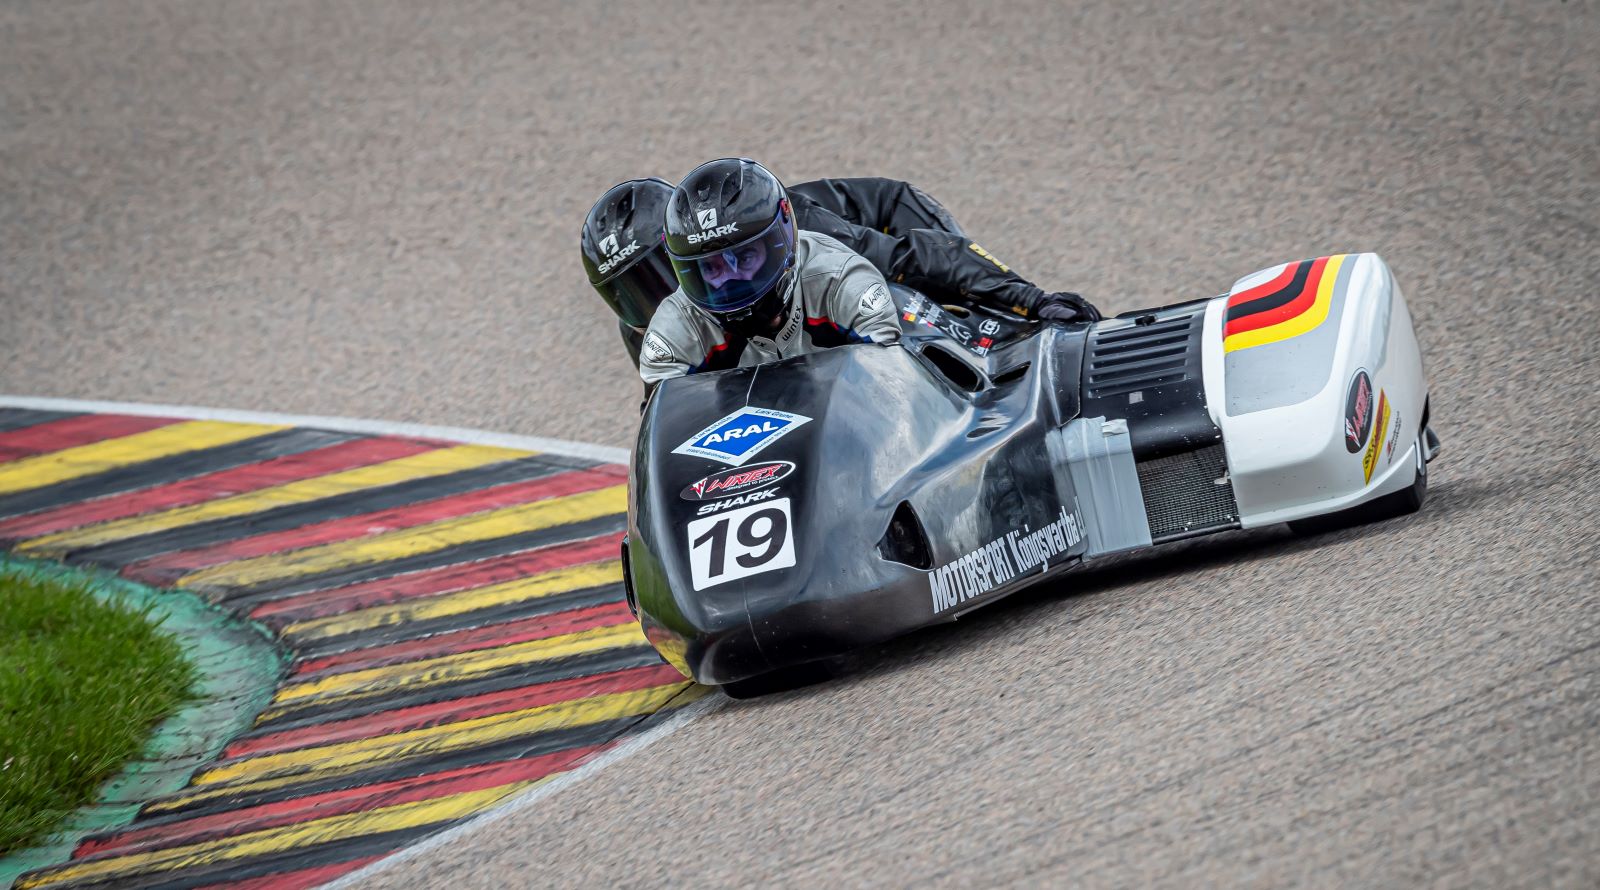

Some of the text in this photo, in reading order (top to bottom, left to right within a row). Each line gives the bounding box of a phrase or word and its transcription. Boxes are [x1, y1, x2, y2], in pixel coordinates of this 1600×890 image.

[687, 222, 739, 244] SHARK
[598, 240, 640, 274] SHARK
[781, 306, 802, 342] wintex
[702, 421, 779, 447] ARAL
[705, 464, 783, 493] WINTEX
[697, 486, 781, 516] SHARK
[693, 508, 788, 579] 19
[928, 536, 1016, 614] MOTORSPORT
[1005, 505, 1081, 573] Königswartha
